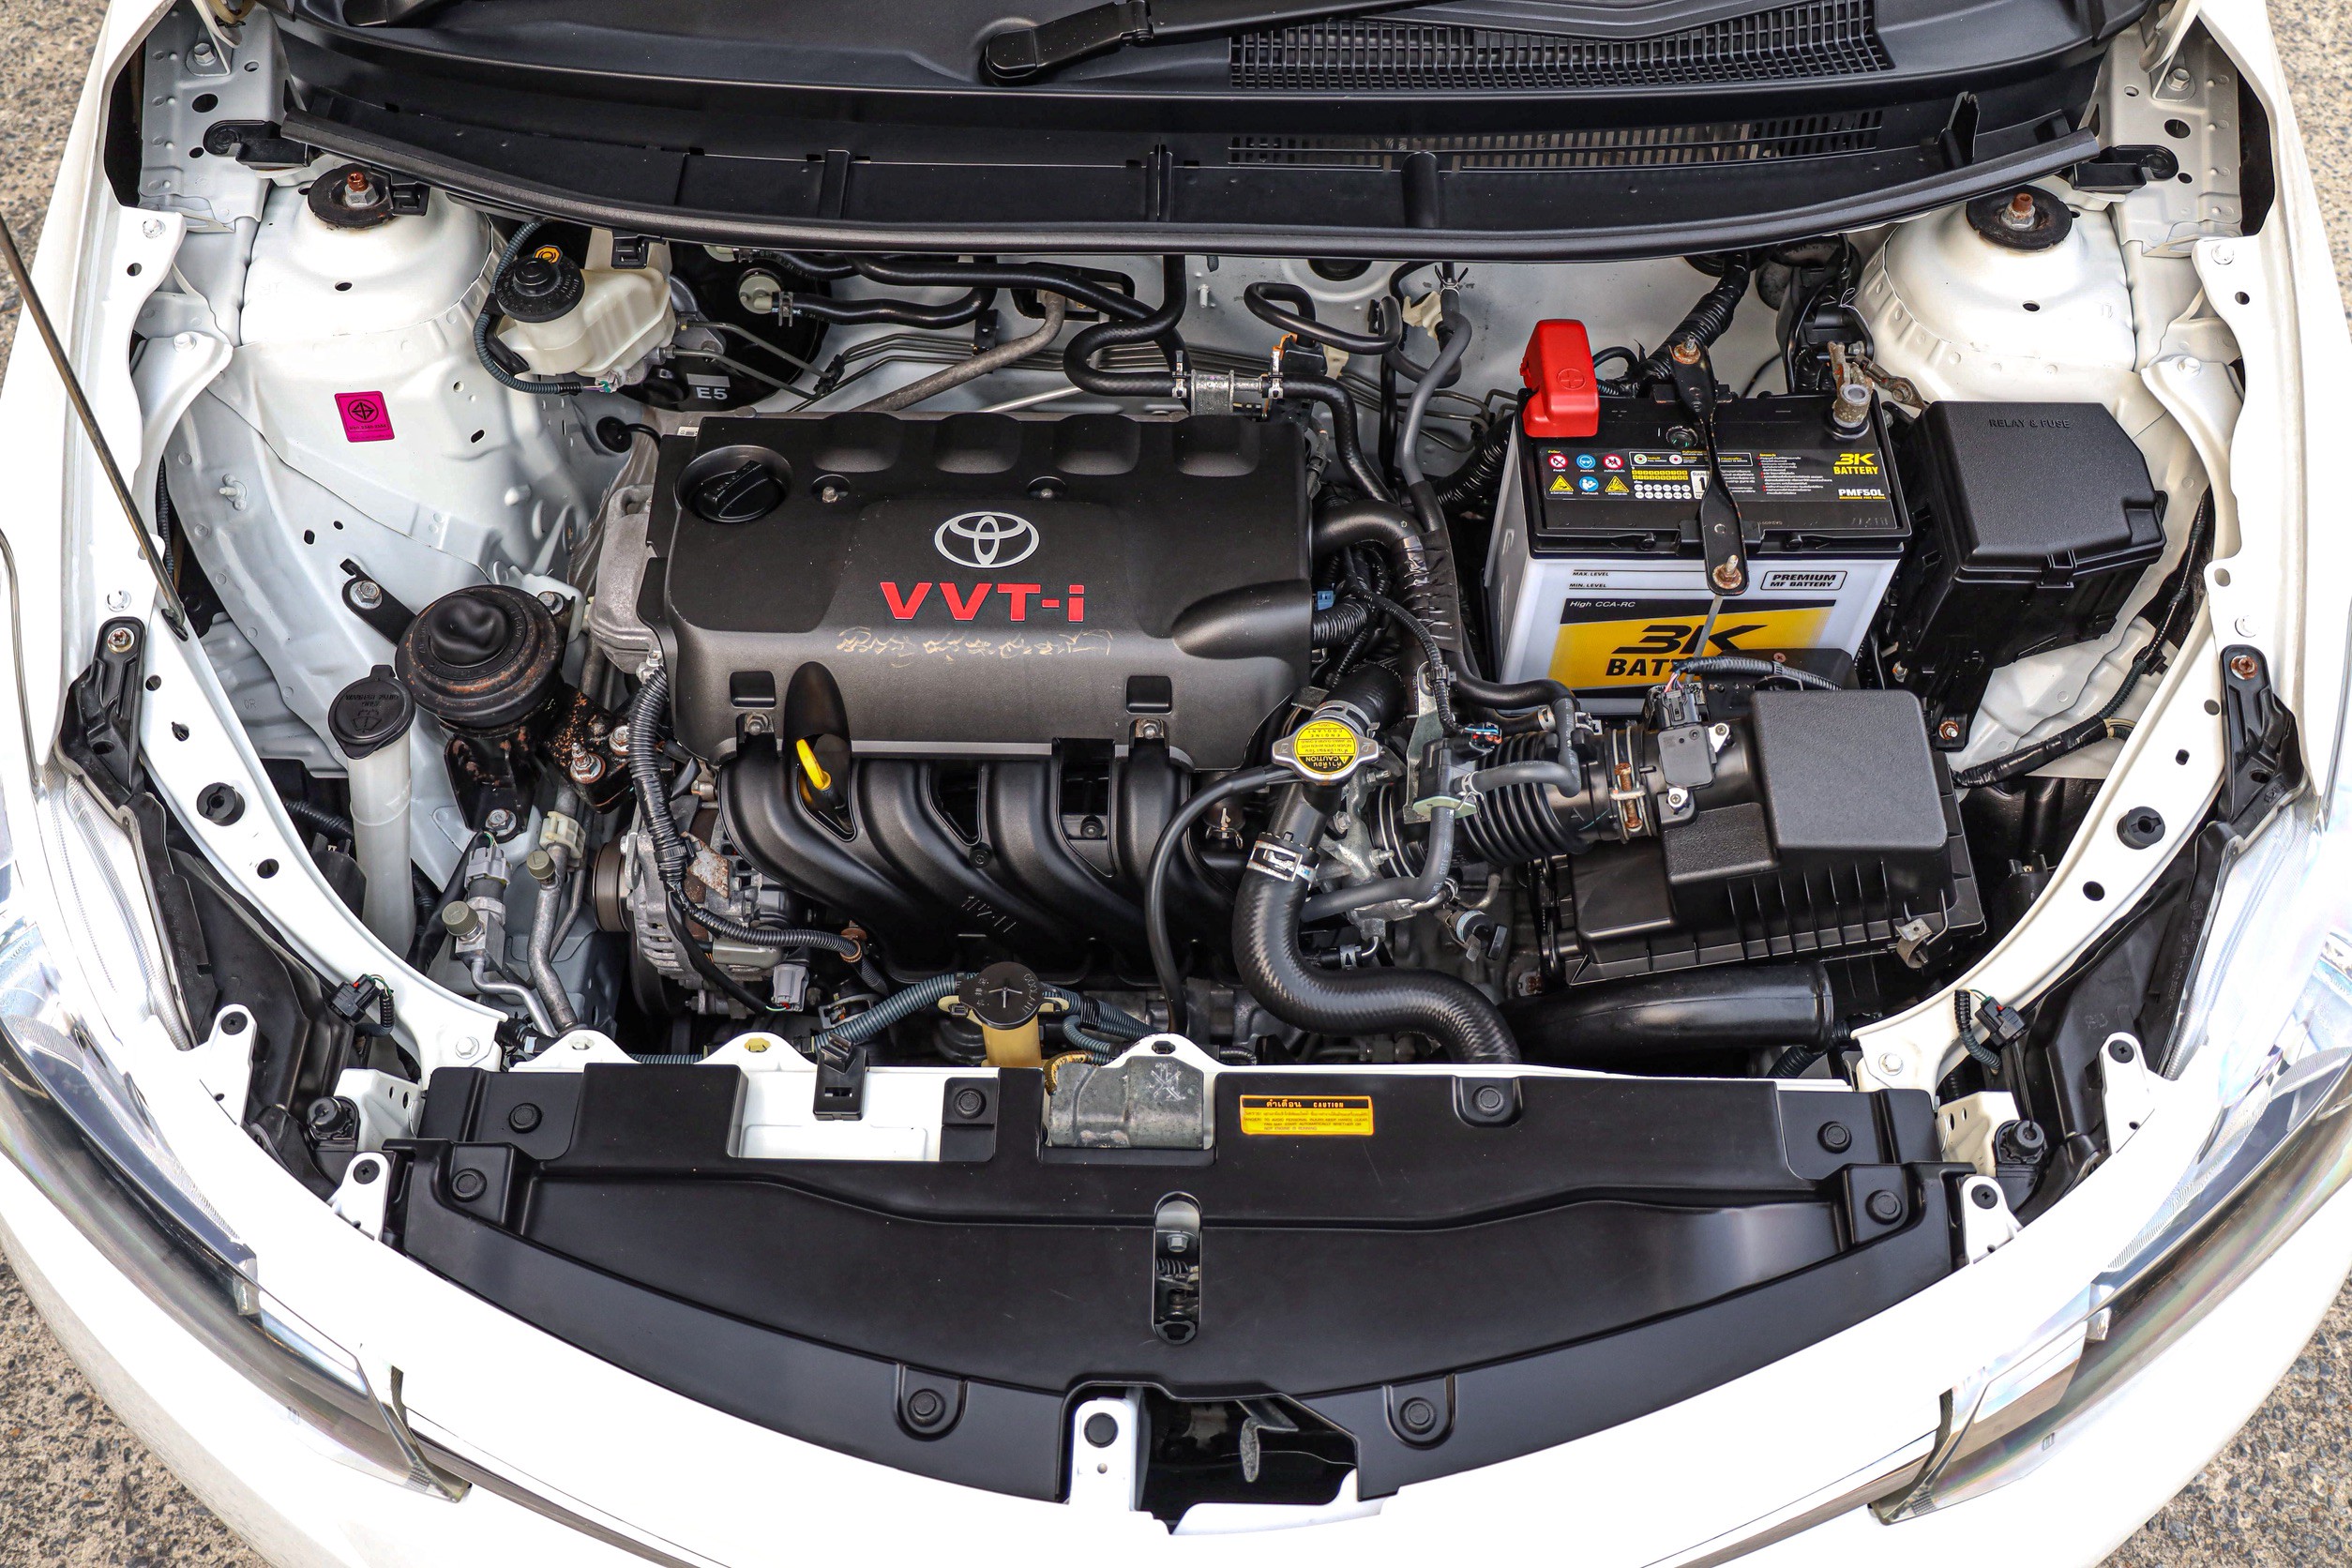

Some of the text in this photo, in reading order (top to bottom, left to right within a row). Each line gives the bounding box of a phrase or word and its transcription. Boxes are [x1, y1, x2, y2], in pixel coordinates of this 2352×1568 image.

[696, 386, 728, 400] E5
[1988, 418, 2071, 429] RELAY & FUSE
[1834, 453, 1876, 465] 3K
[1833, 466, 1878, 475] BATTERY
[1837, 489, 1885, 497] PMF50L
[880, 581, 1085, 622] VVT-i
[1611, 625, 1768, 655] 3K
[1266, 1098, 1302, 1108] คำเตือน
